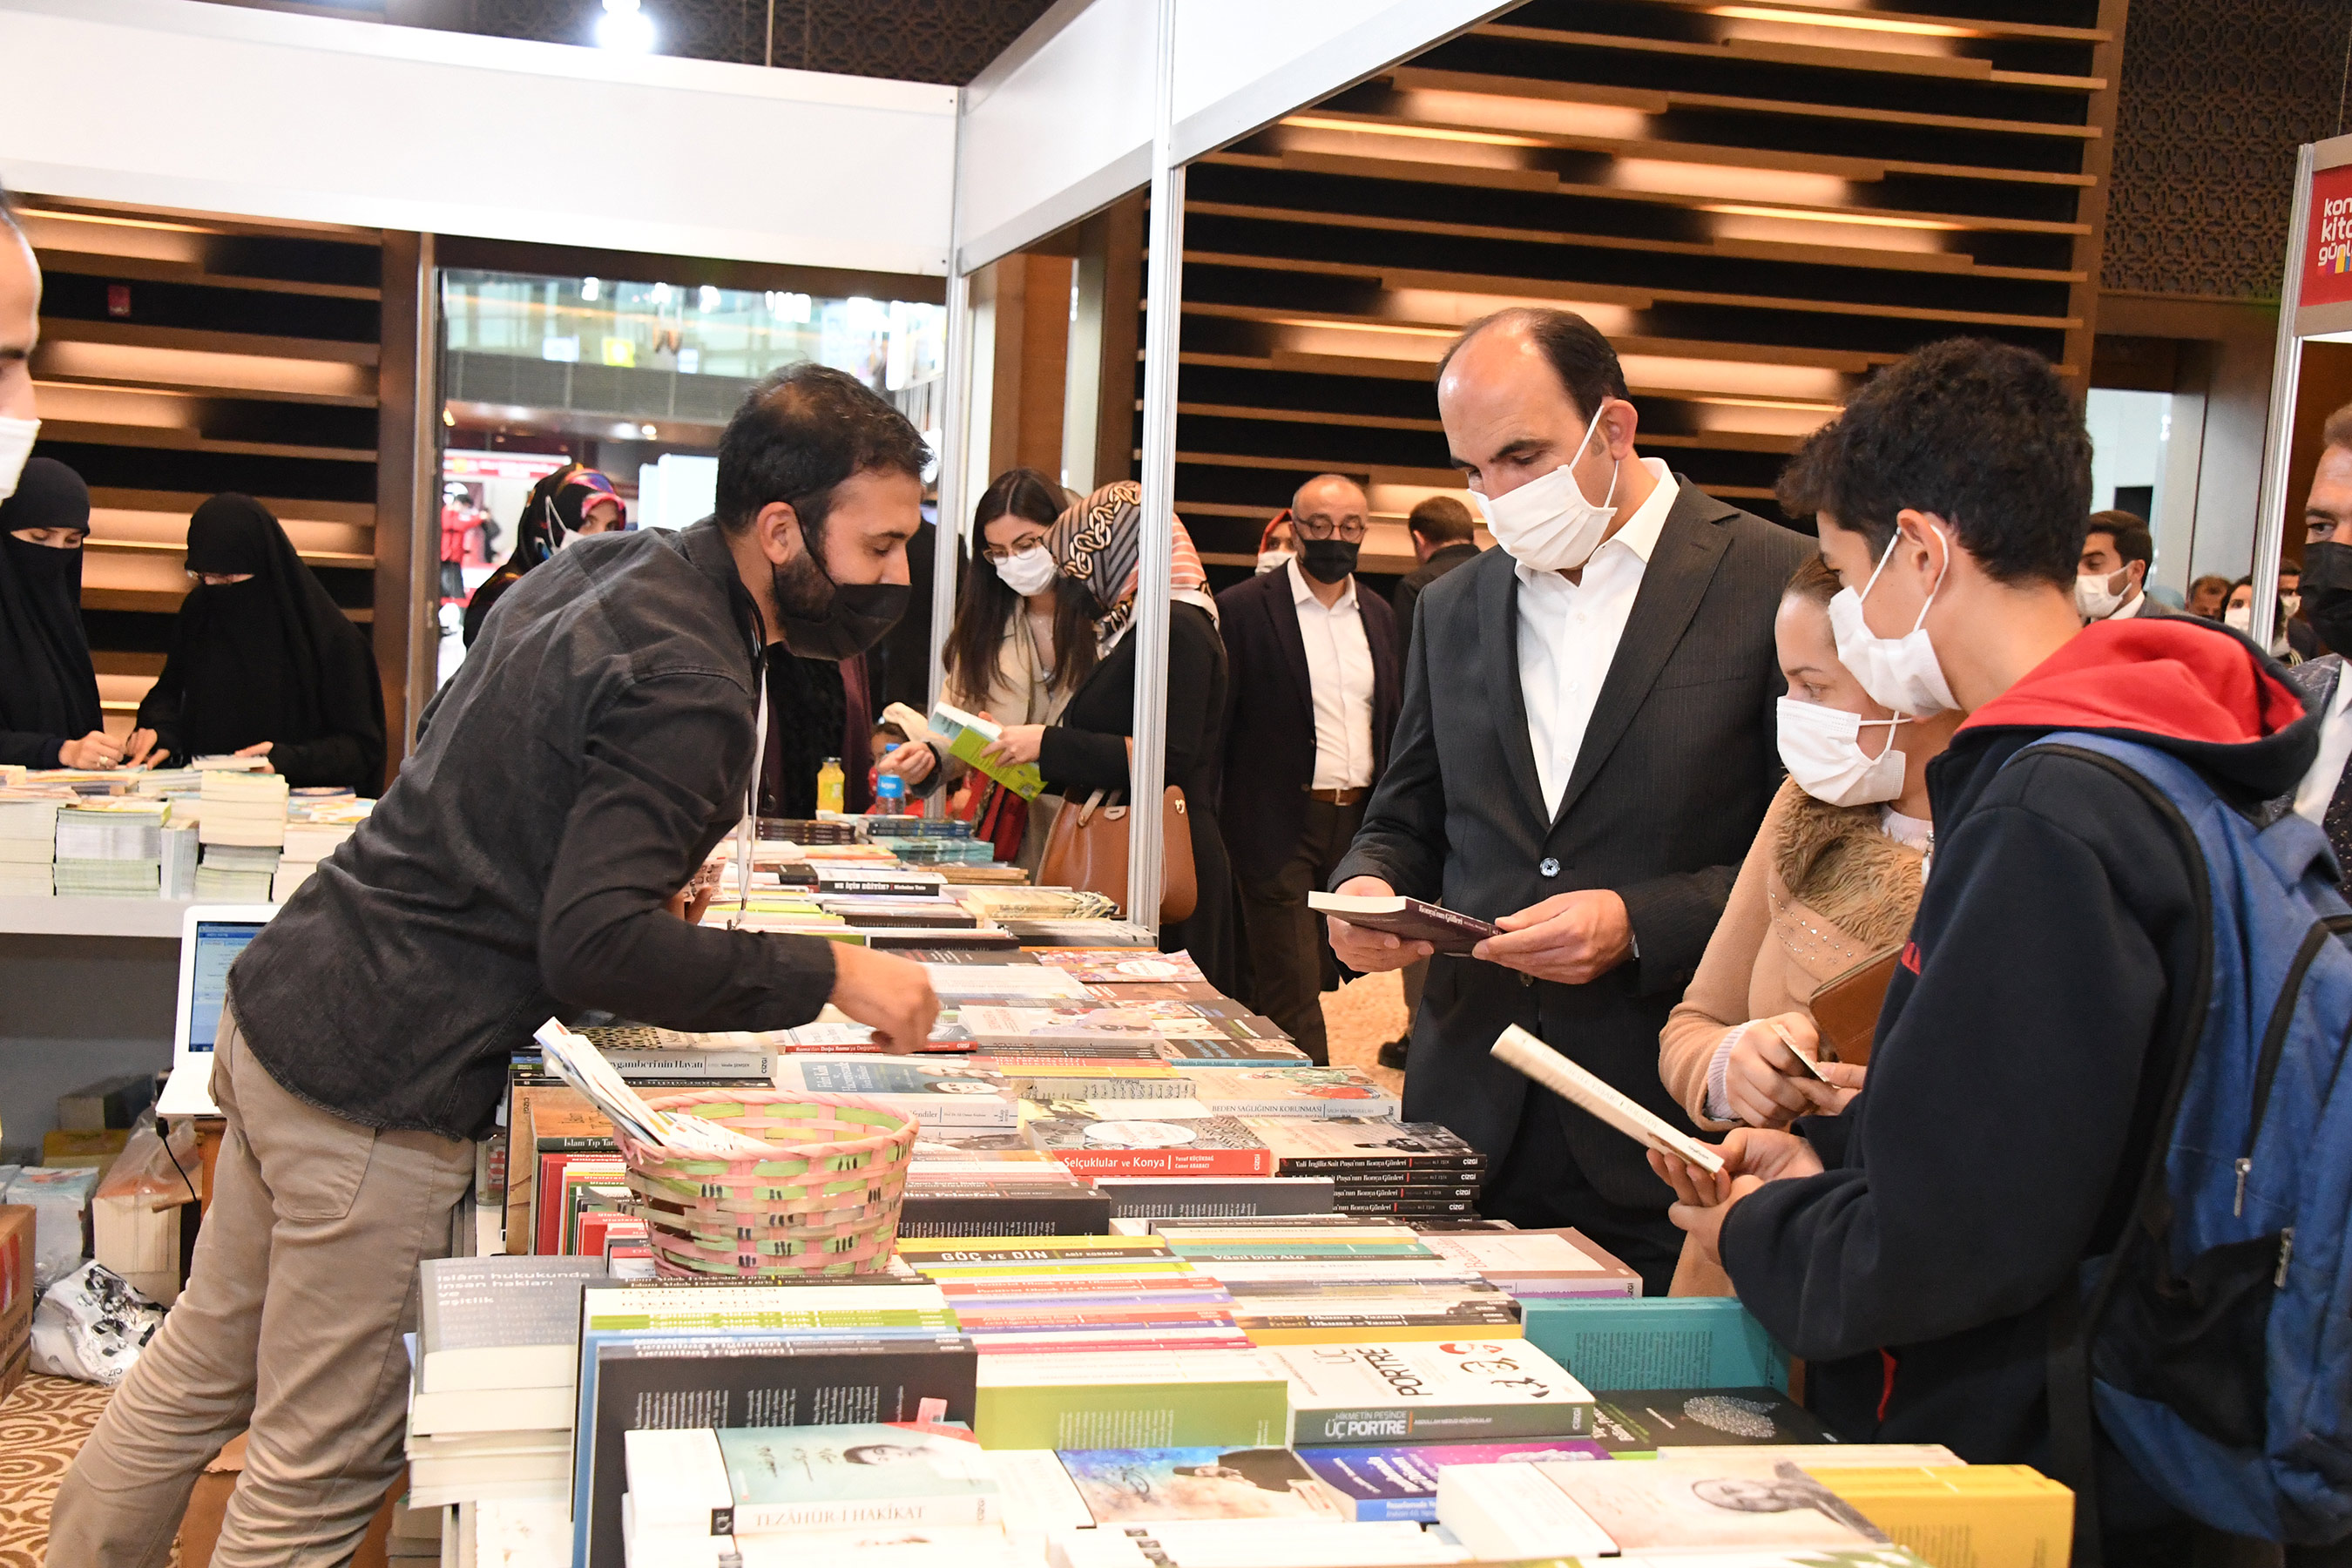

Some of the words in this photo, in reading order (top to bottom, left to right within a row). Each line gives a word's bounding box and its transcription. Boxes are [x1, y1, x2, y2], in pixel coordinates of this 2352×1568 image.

[2323, 198, 2352, 218] kon
[2318, 240, 2352, 267] günl
[610, 1058, 672, 1071] ygamberi'nin
[759, 1057, 768, 1075] ÇİZGİ
[1212, 1105, 1236, 1113] BEDEN
[1237, 1103, 1278, 1113] SAĞLIĞININ
[1279, 1104, 1322, 1113] KORUNMASI
[912, 1109, 937, 1119] fendiler
[564, 1137, 585, 1146] İslam
[587, 1138, 602, 1148] Tıp
[602, 1138, 615, 1146] Tar
[1064, 1156, 1118, 1170] Selçuklular
[1132, 1157, 1165, 1170] Konya
[1463, 1157, 1478, 1166] ÇİZGİ
[1461, 1173, 1477, 1181] ÇİZGİ
[1334, 1188, 1356, 1197] aşa'nın
[1455, 1187, 1471, 1197] ÇİZGİ
[1449, 1202, 1465, 1211] ÇİZGİ
[941, 1250, 983, 1262] GÖÇ
[1011, 1248, 1048, 1260] DİN
[490, 1271, 591, 1281] hukukunda
[437, 1281, 487, 1289] insan
[492, 1279, 553, 1288] hakları
[438, 1296, 495, 1307] eşitlik
[1313, 1348, 1356, 1365] ÜÇ
[1355, 1347, 1434, 1396] PORTRE
[1335, 1411, 1373, 1420] HİKMETİN
[1374, 1410, 1407, 1421] PEŞİNDE
[1325, 1418, 1347, 1439] ÜÇ
[1348, 1419, 1407, 1436] PORTRE
[754, 1508, 848, 1528] TEZÂHÜR-İ
[852, 1503, 927, 1523] HAKÎKAT
